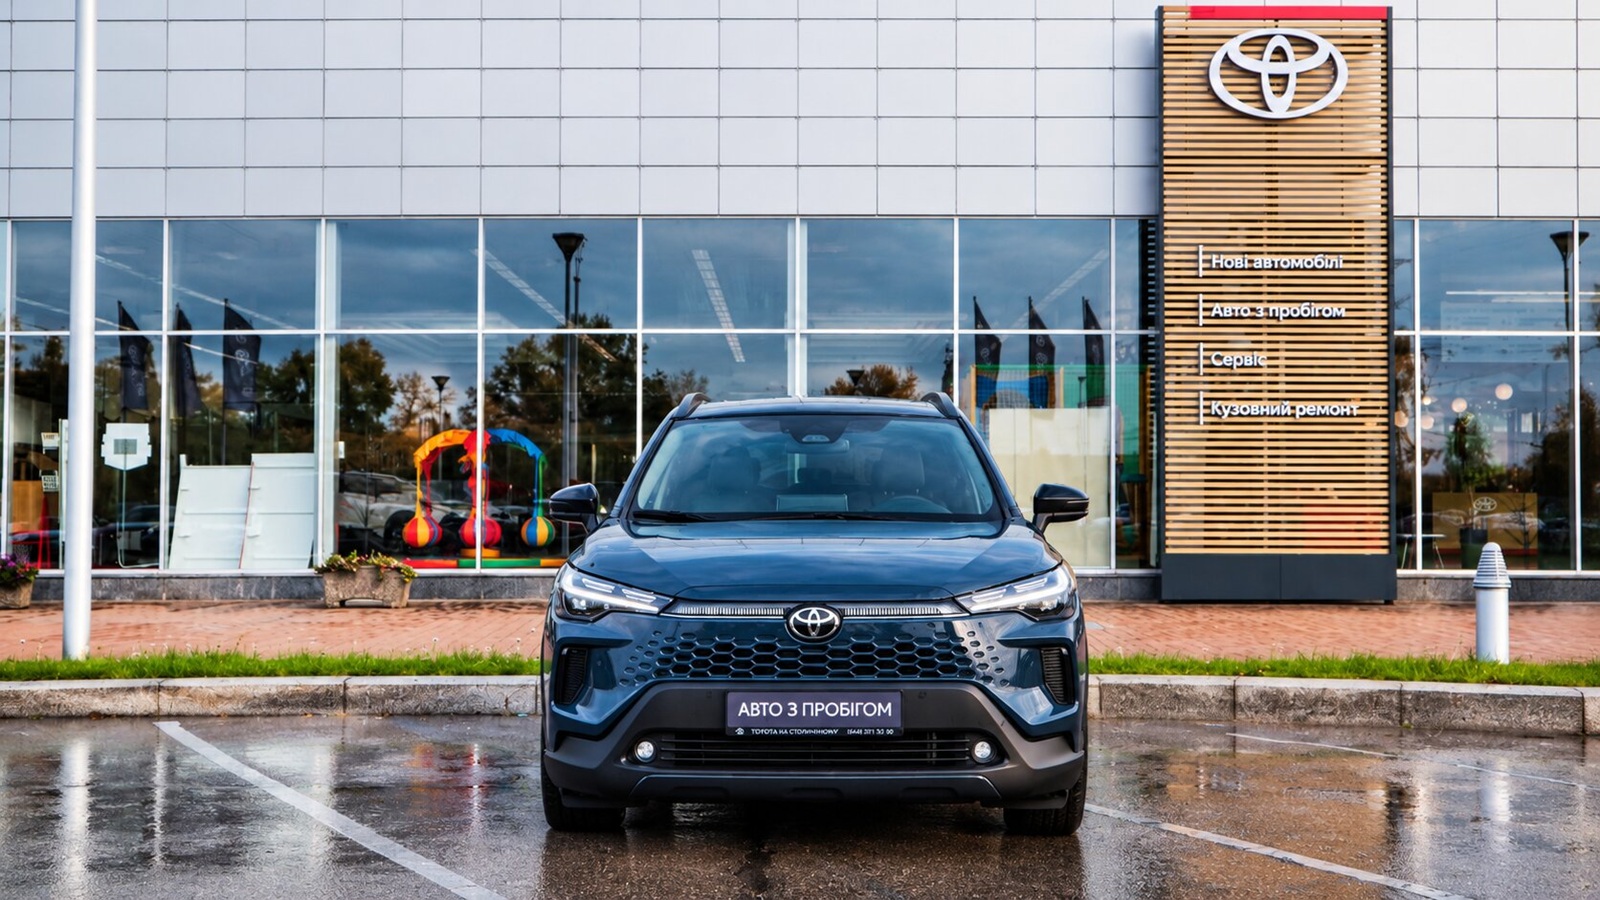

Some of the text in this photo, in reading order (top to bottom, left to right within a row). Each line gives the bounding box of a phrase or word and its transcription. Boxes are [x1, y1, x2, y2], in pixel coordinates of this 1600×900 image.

[1211, 254, 1343, 269] Нові автомобілі
[1211, 302, 1346, 320] Авто з пробігом
[1211, 351, 1267, 369] Сервіс
[1211, 400, 1359, 418] Кузовний ремонт
[738, 702, 892, 717] АВТО З ПРОБІГОМ
